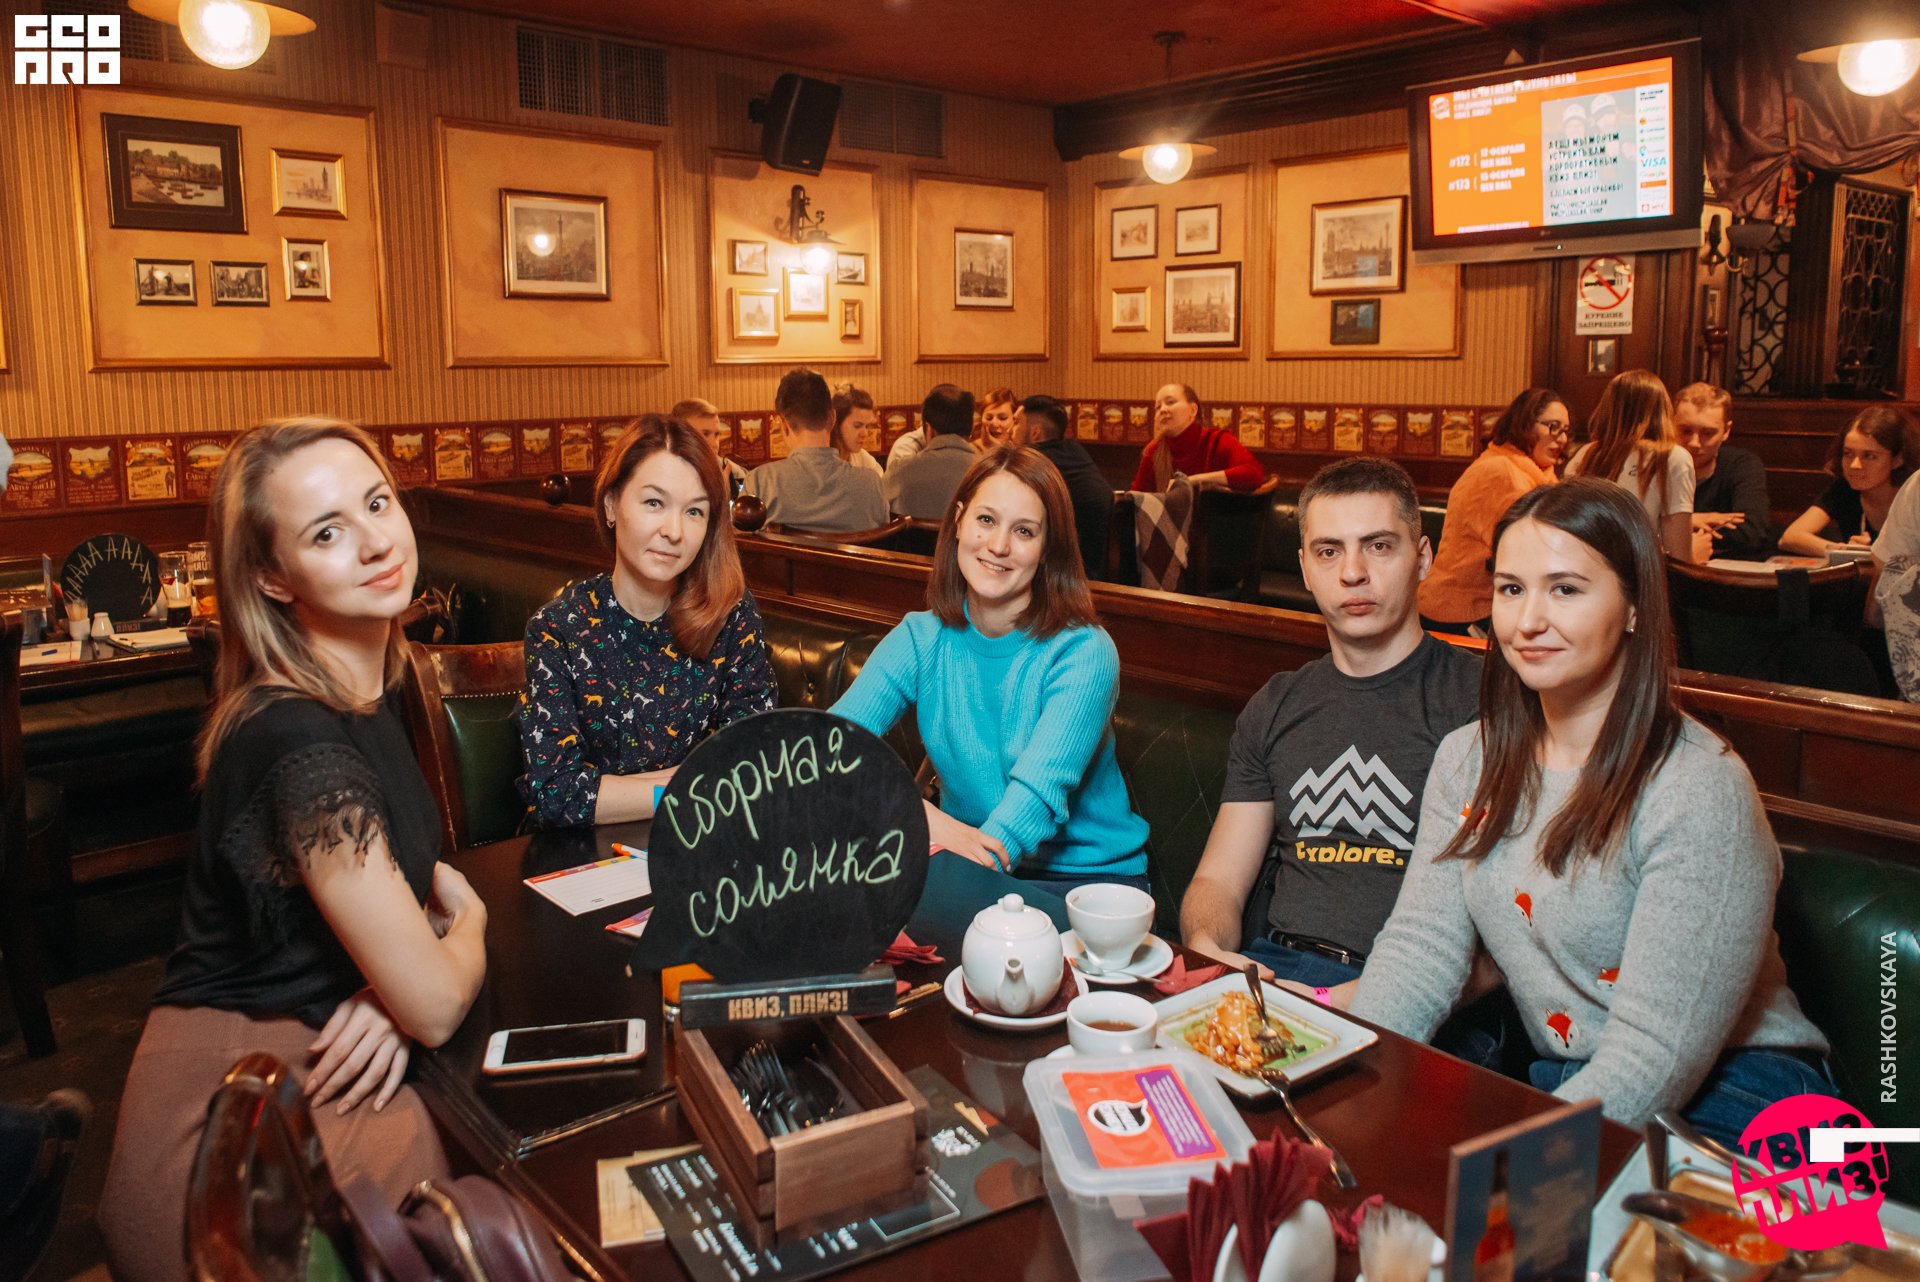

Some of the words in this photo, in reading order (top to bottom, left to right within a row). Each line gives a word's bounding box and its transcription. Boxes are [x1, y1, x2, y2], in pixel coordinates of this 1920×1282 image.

[1641, 157, 1667, 167] VISA
[1585, 312, 1624, 320] КУРЕНИЕ
[1578, 321, 1632, 329] ЗАПРЕЩЕНО
[728, 995, 785, 1022] КВИЗ,
[789, 990, 849, 1016] ПЛИЗ!
